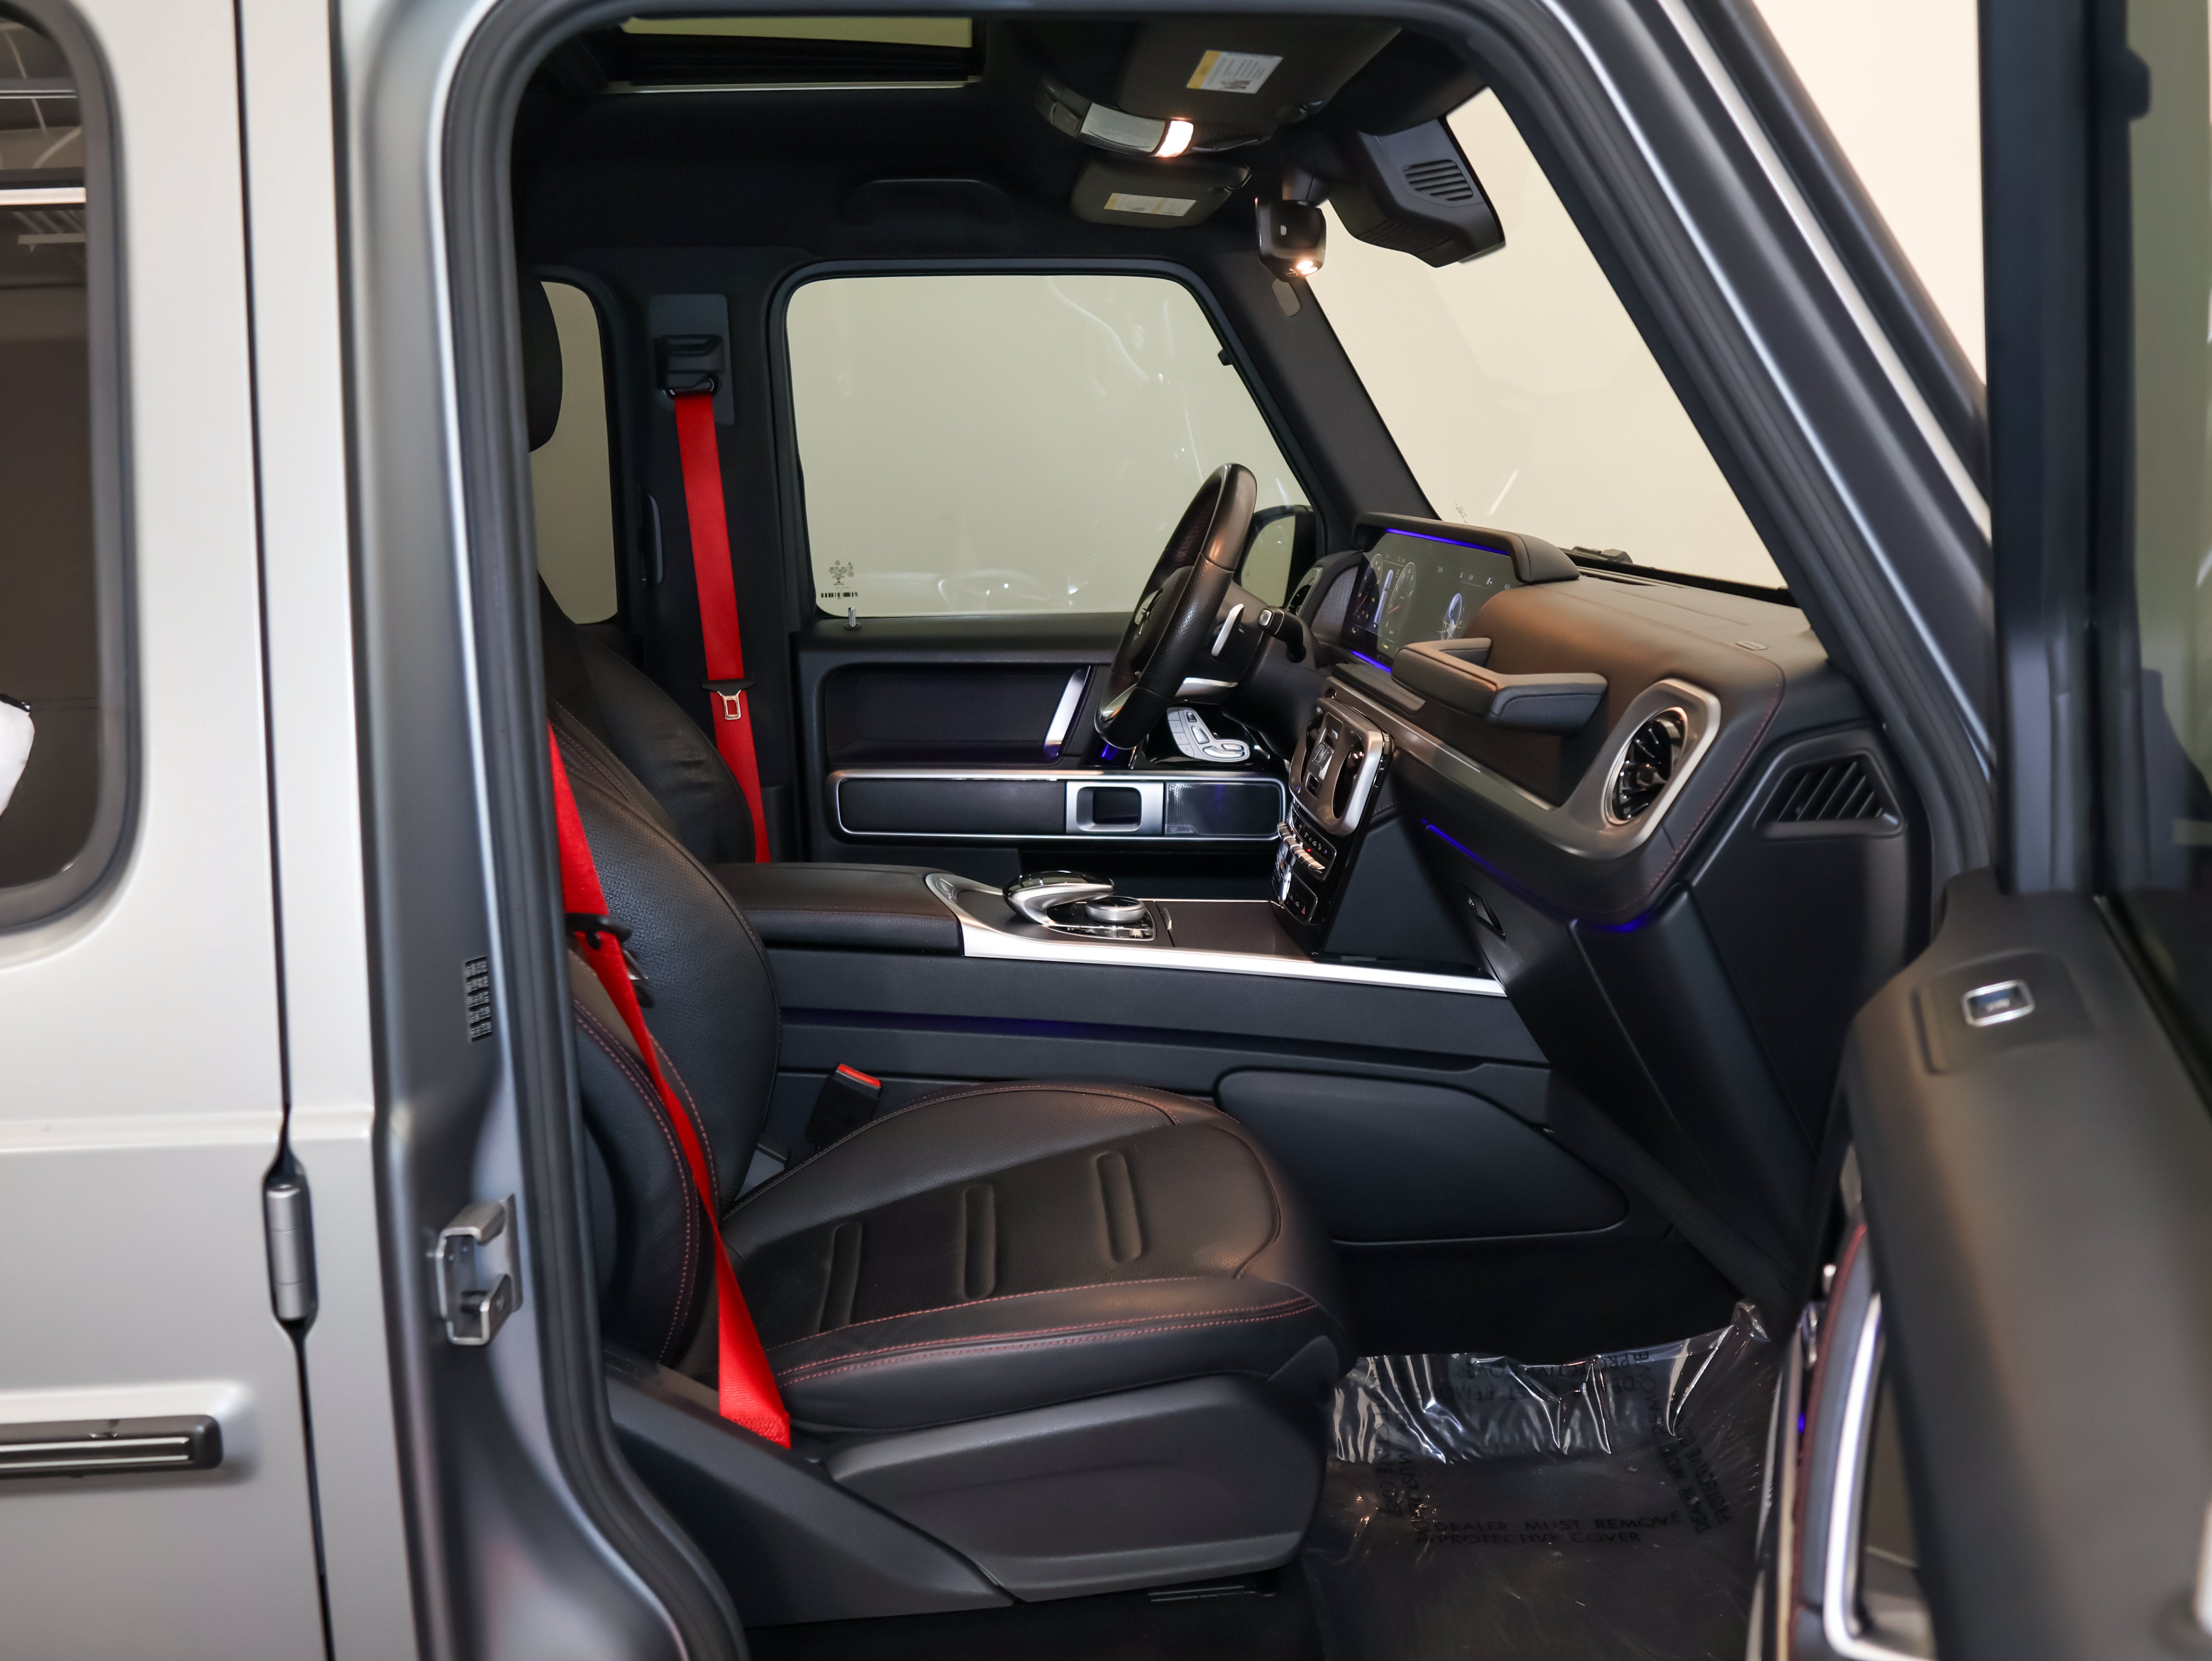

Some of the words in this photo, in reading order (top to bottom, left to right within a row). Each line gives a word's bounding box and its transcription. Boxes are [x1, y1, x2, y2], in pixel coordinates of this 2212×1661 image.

[1436, 1521, 1508, 1531] DEALER
[1526, 1519, 1580, 1531] MUST
[1595, 1510, 1682, 1529] REMOVE
[1439, 1534, 1562, 1544] PROTECTIVE
[1572, 1531, 1642, 1543] COVER
